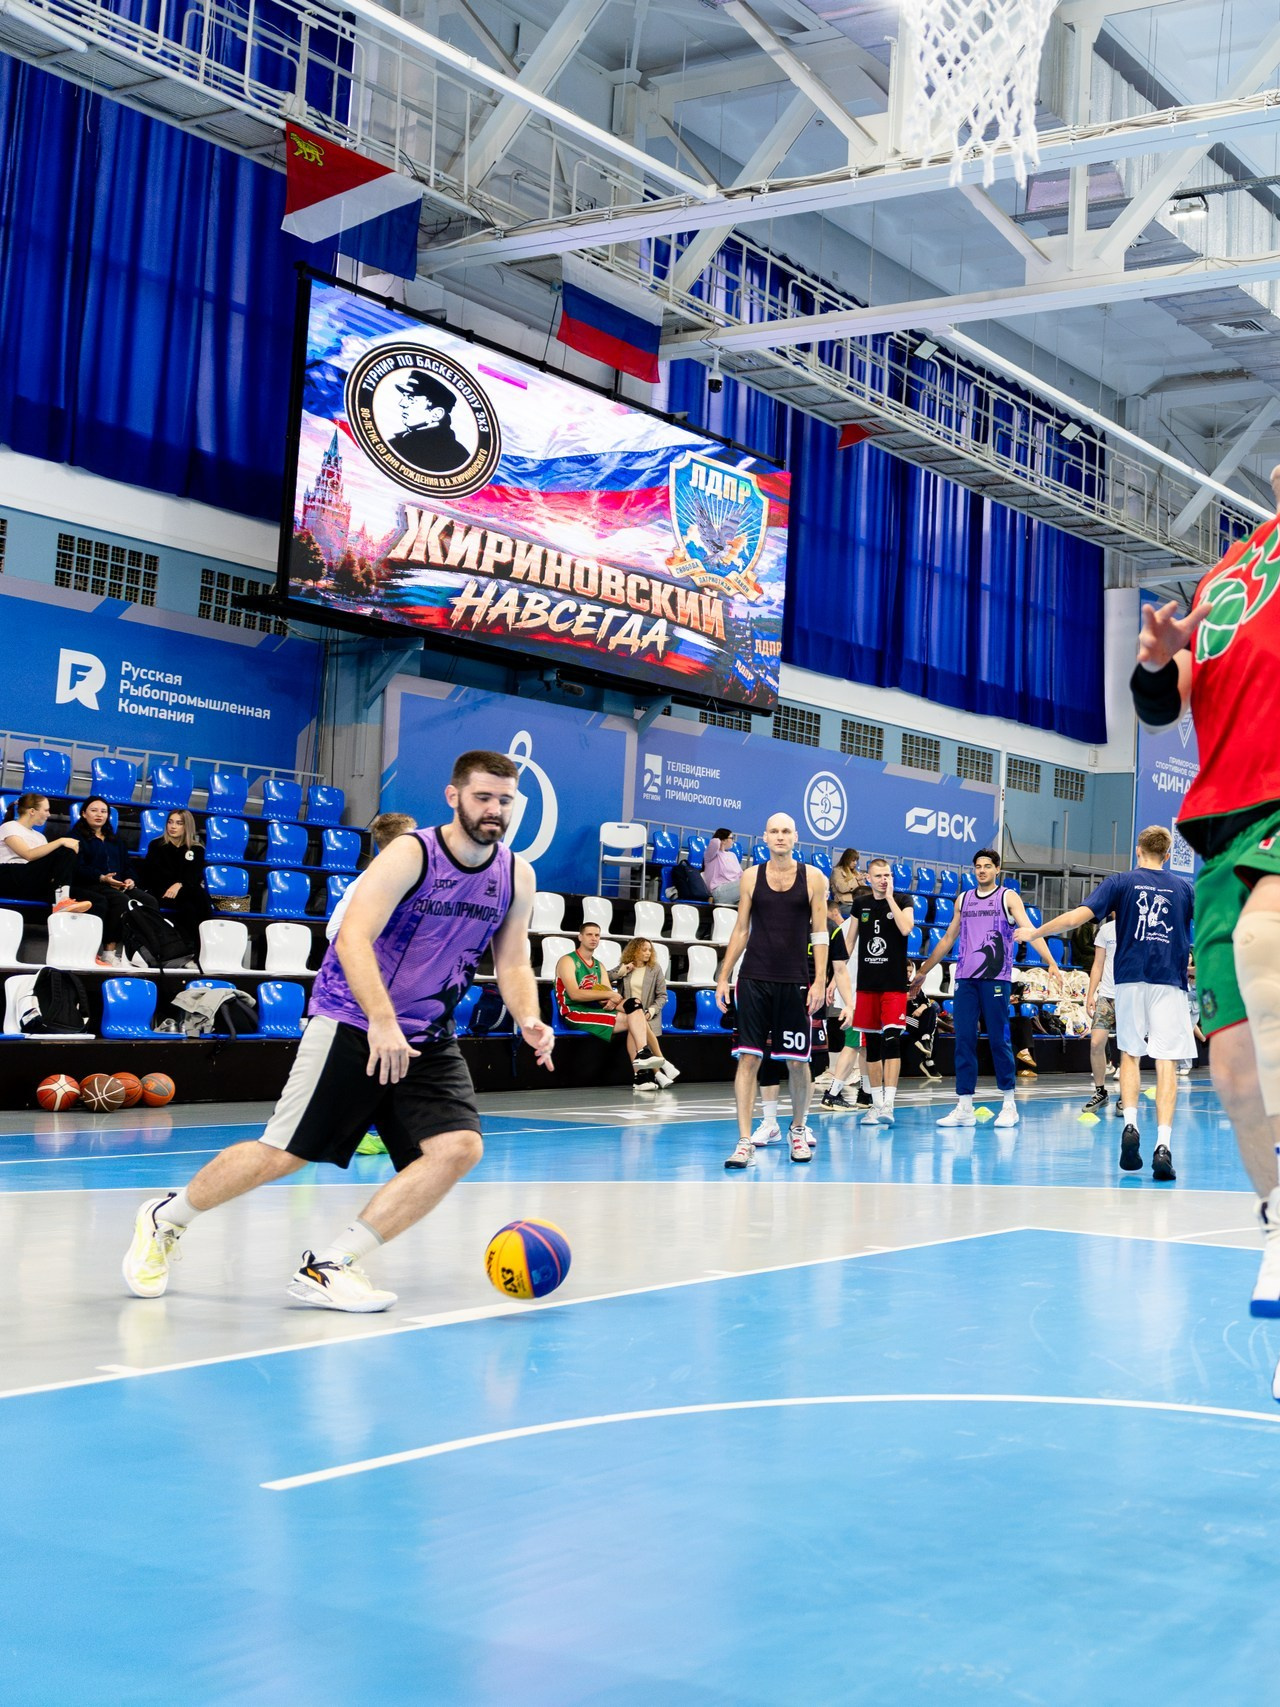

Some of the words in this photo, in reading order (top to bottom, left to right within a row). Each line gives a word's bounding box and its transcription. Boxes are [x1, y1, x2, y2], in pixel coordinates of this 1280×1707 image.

[362, 357, 396, 392] ТУРНИР
[396, 354, 414, 367] ПО
[416, 356, 482, 409] БАСКЕТБОЛУ
[360, 407, 381, 444] 80-ЛЕТИЕ
[375, 442, 388, 455] СО
[383, 452, 401, 469] ДНЯ
[398, 464, 440, 488] РОЖДЕНИЯ
[689, 463, 752, 505] ЛДПР
[386, 504, 727, 641] ЖИРИНОВСКИЙ
[447, 579, 671, 660] НАВСЕГДА
[754, 639, 782, 658] ЛДПР
[121, 661, 182, 686] Русская
[117, 698, 195, 724] Компания
[119, 679, 271, 720] Рыбопромышленная
[665, 775, 672, 785] И
[673, 775, 700, 789] РАДИО
[666, 760, 721, 779] ТЕЛЕВИДЕНИЕ
[642, 792, 661, 802] РЕГИОН
[665, 789, 721, 807] ПРИМОРСКОГО
[722, 798, 742, 810] КРАЯ
[937, 811, 977, 843] ВСК
[874, 919, 881, 934] 5
[783, 1031, 806, 1050] 50
